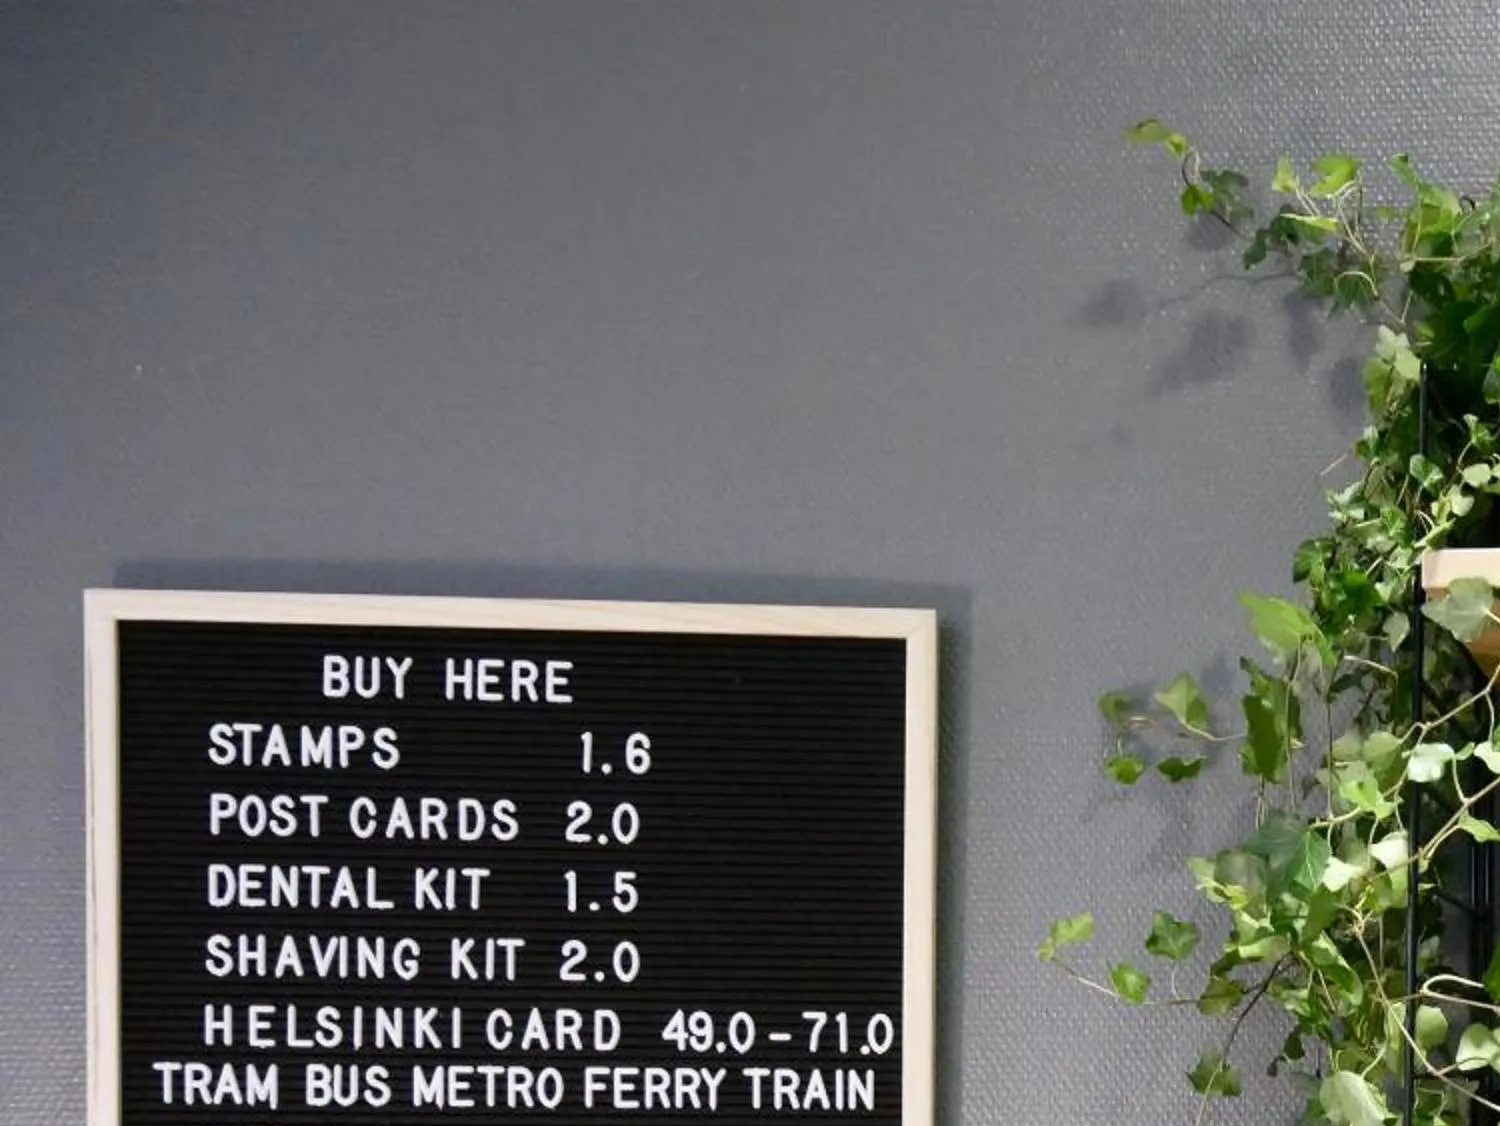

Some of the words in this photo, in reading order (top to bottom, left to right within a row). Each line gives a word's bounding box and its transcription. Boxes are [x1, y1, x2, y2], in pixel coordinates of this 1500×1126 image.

[322, 654, 413, 699] BUY
[445, 657, 574, 704] HERE
[207, 722, 400, 770] STAMPS
[580, 731, 651, 775] 1.6
[210, 792, 329, 838] POST
[349, 796, 519, 841] CARDS
[565, 800, 640, 845] 2.0
[207, 863, 395, 910] DENTAL
[414, 867, 491, 911] KIT
[564, 870, 639, 913] 1.5
[205, 933, 421, 981] SHAVING
[451, 937, 526, 981] KIT
[559, 939, 641, 983] 2.0
[204, 1003, 461, 1051] HELSINKI
[485, 1007, 621, 1052] CARD
[152, 1061, 279, 1110] TRAM
[305, 1063, 392, 1108] BUS
[412, 1064, 565, 1110] METRO
[584, 1066, 727, 1111] FERRY
[742, 1067, 875, 1111] TRAIN
